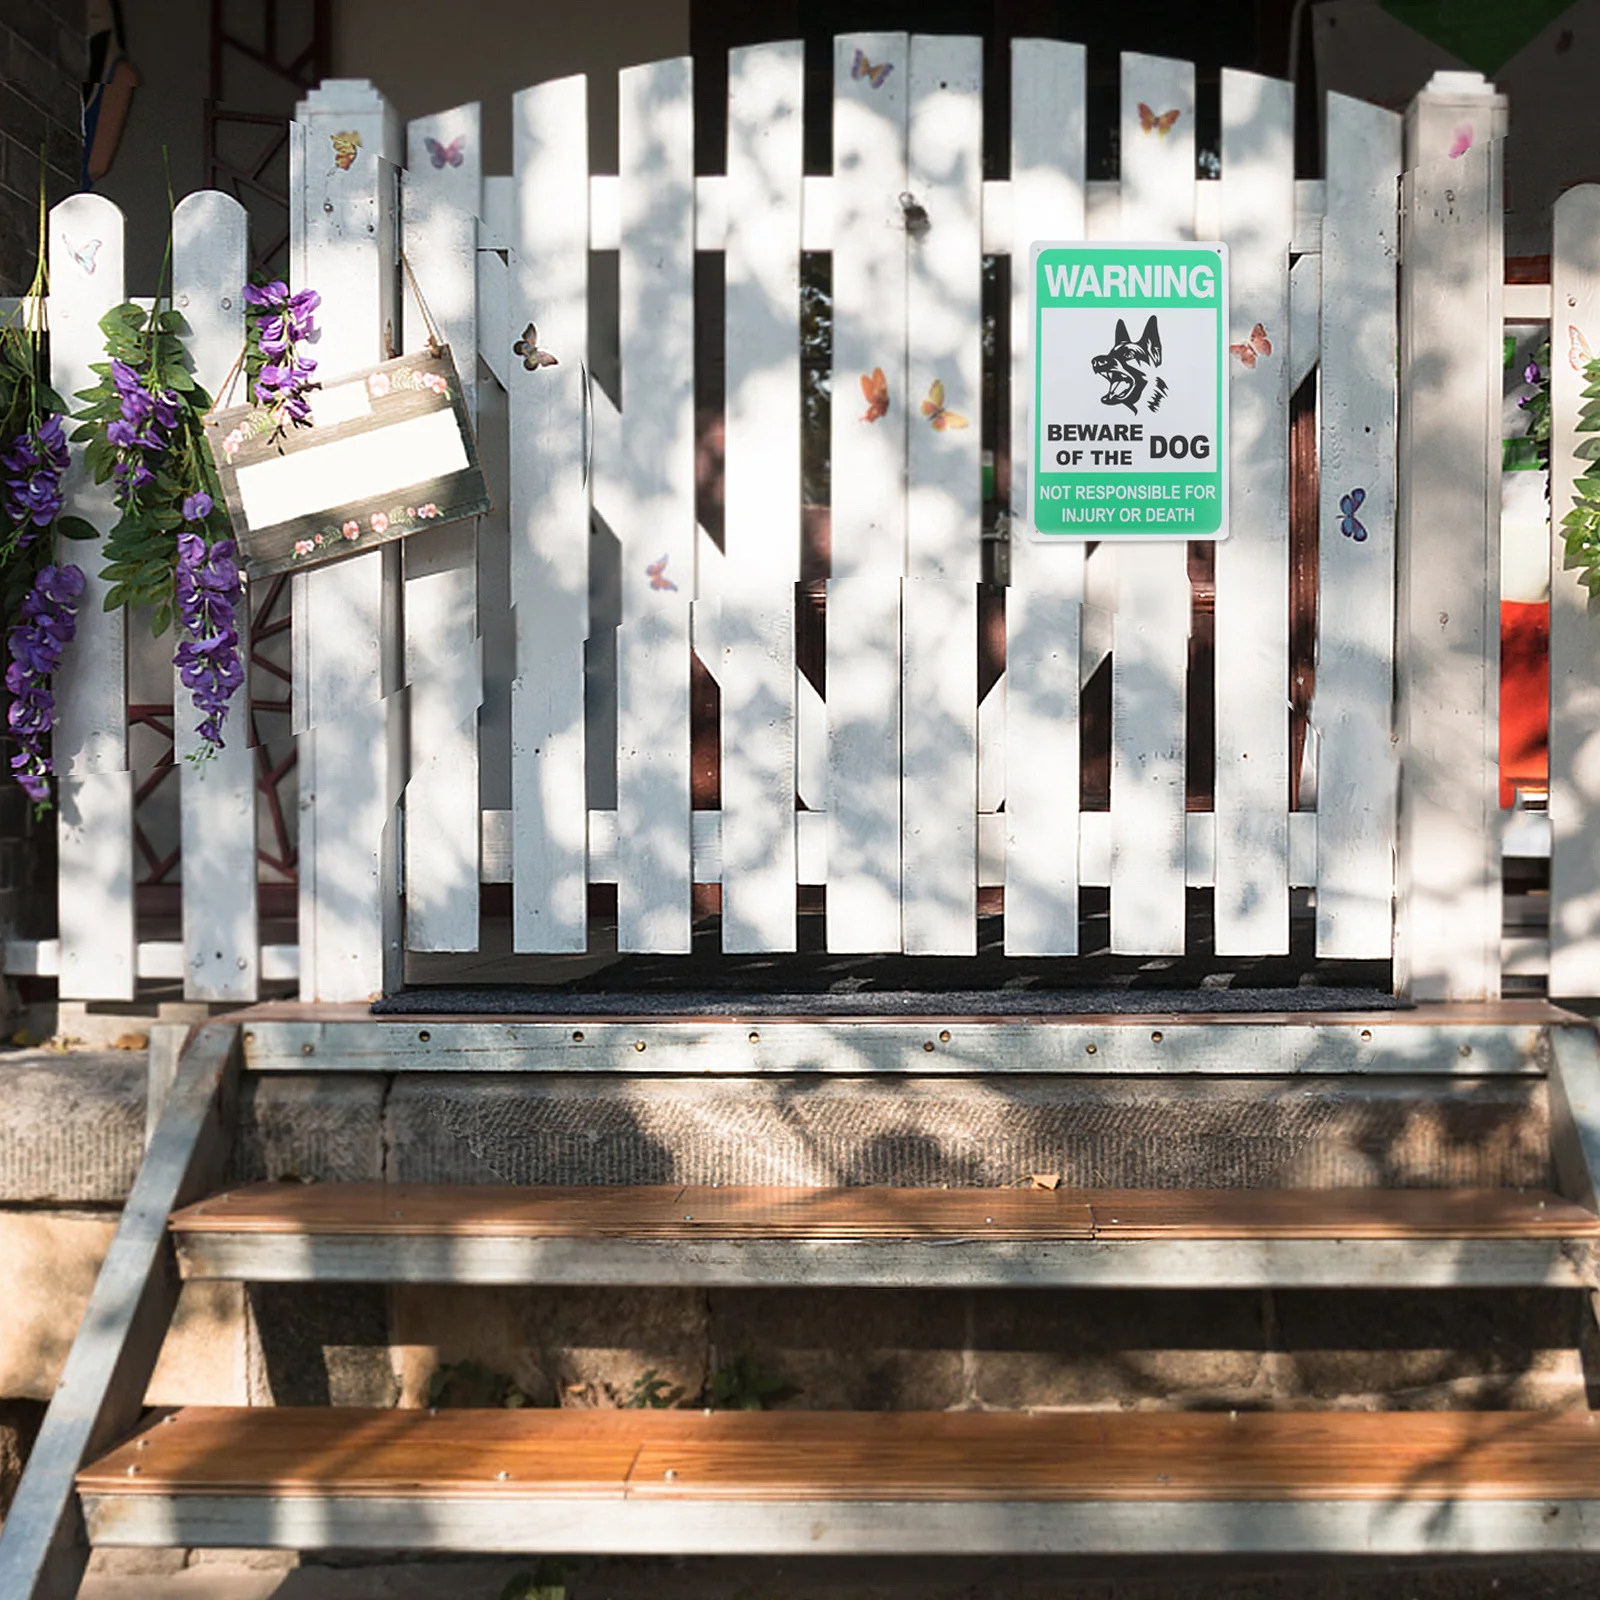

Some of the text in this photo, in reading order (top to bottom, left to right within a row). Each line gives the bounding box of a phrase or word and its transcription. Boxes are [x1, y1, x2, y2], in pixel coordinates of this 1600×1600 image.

[1044, 264, 1215, 299] WARNING
[1047, 424, 1143, 442] BEWARE
[1149, 434, 1210, 459] DOG
[1056, 450, 1132, 466] OF THE
[1039, 484, 1216, 500] NOT RESPONSIBLE FOR
[1061, 507, 1195, 523] INJURY OR DEATH
